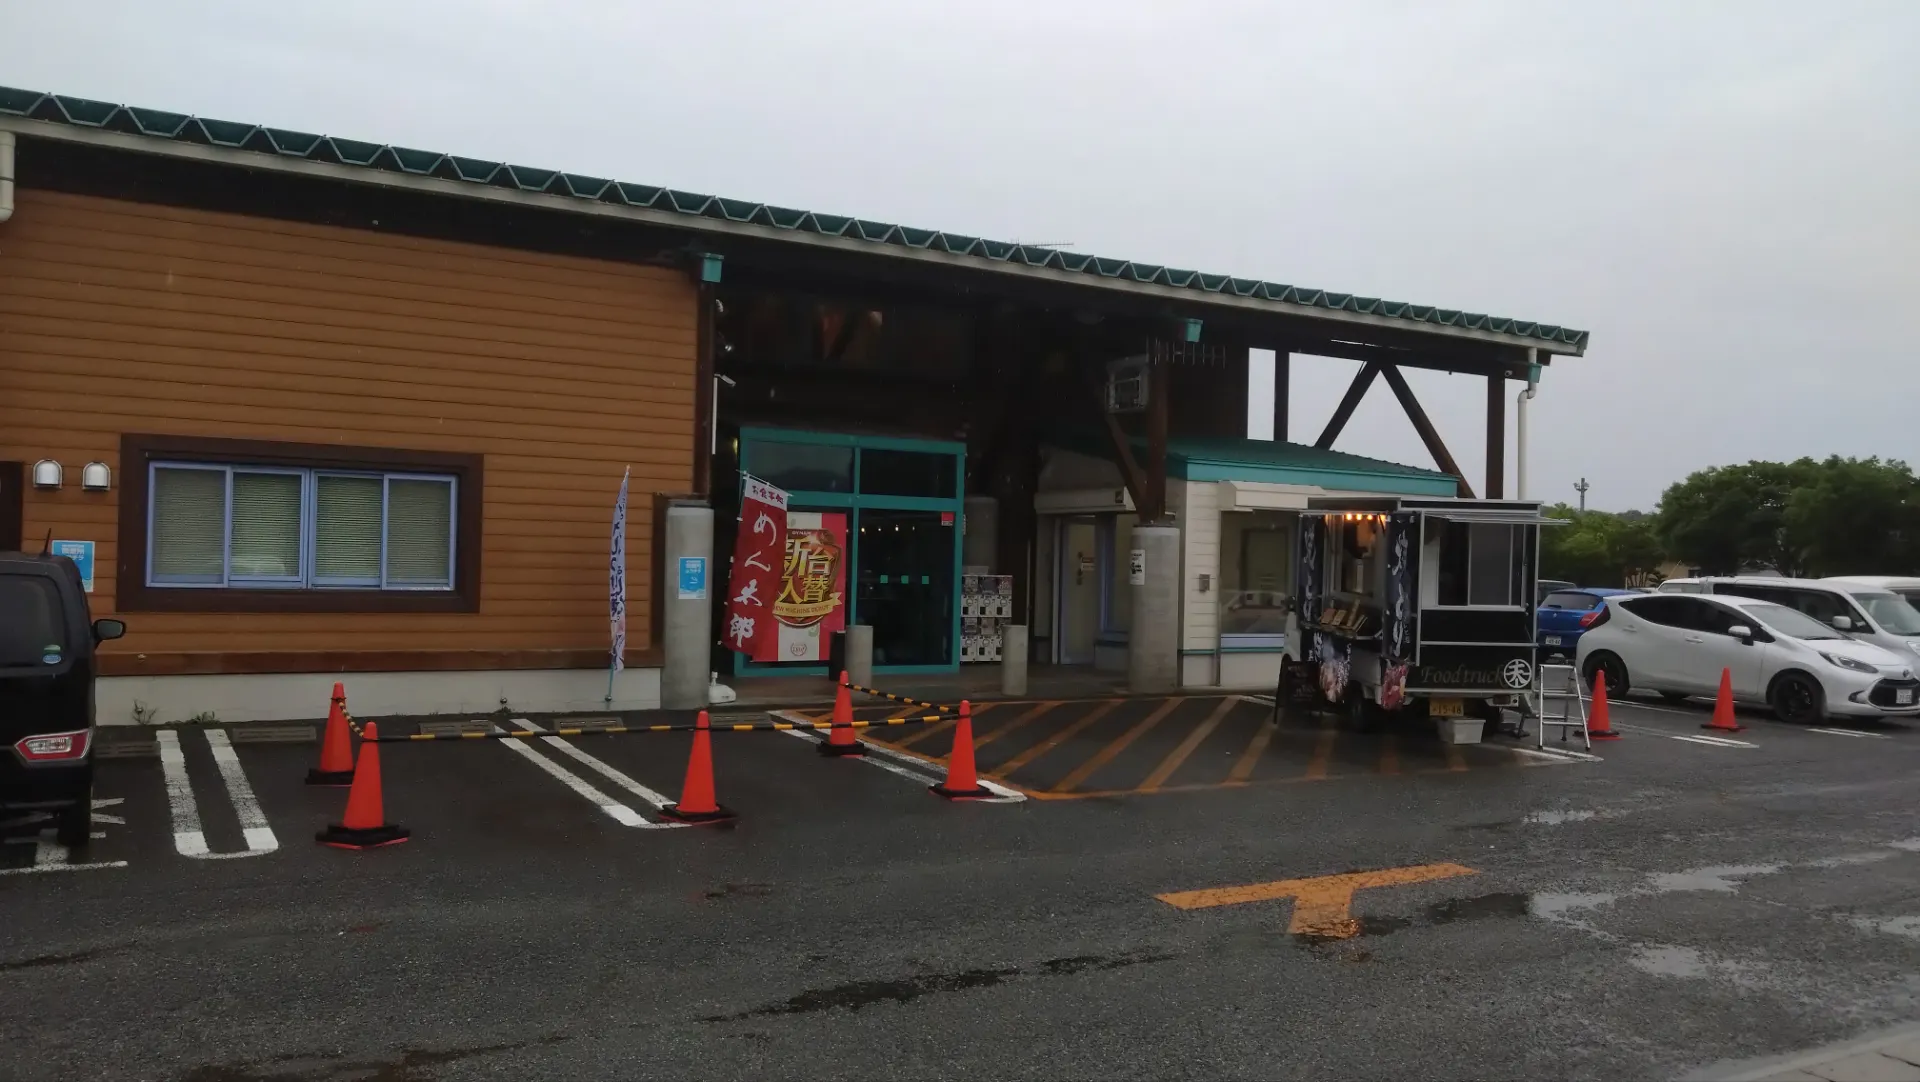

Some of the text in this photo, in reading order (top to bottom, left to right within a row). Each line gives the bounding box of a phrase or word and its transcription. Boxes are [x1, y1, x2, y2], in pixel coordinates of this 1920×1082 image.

[751, 485, 784, 505] お食事処
[783, 537, 834, 578] 新台
[779, 575, 829, 605] 入替
[1421, 662, 1507, 687] Food truck
